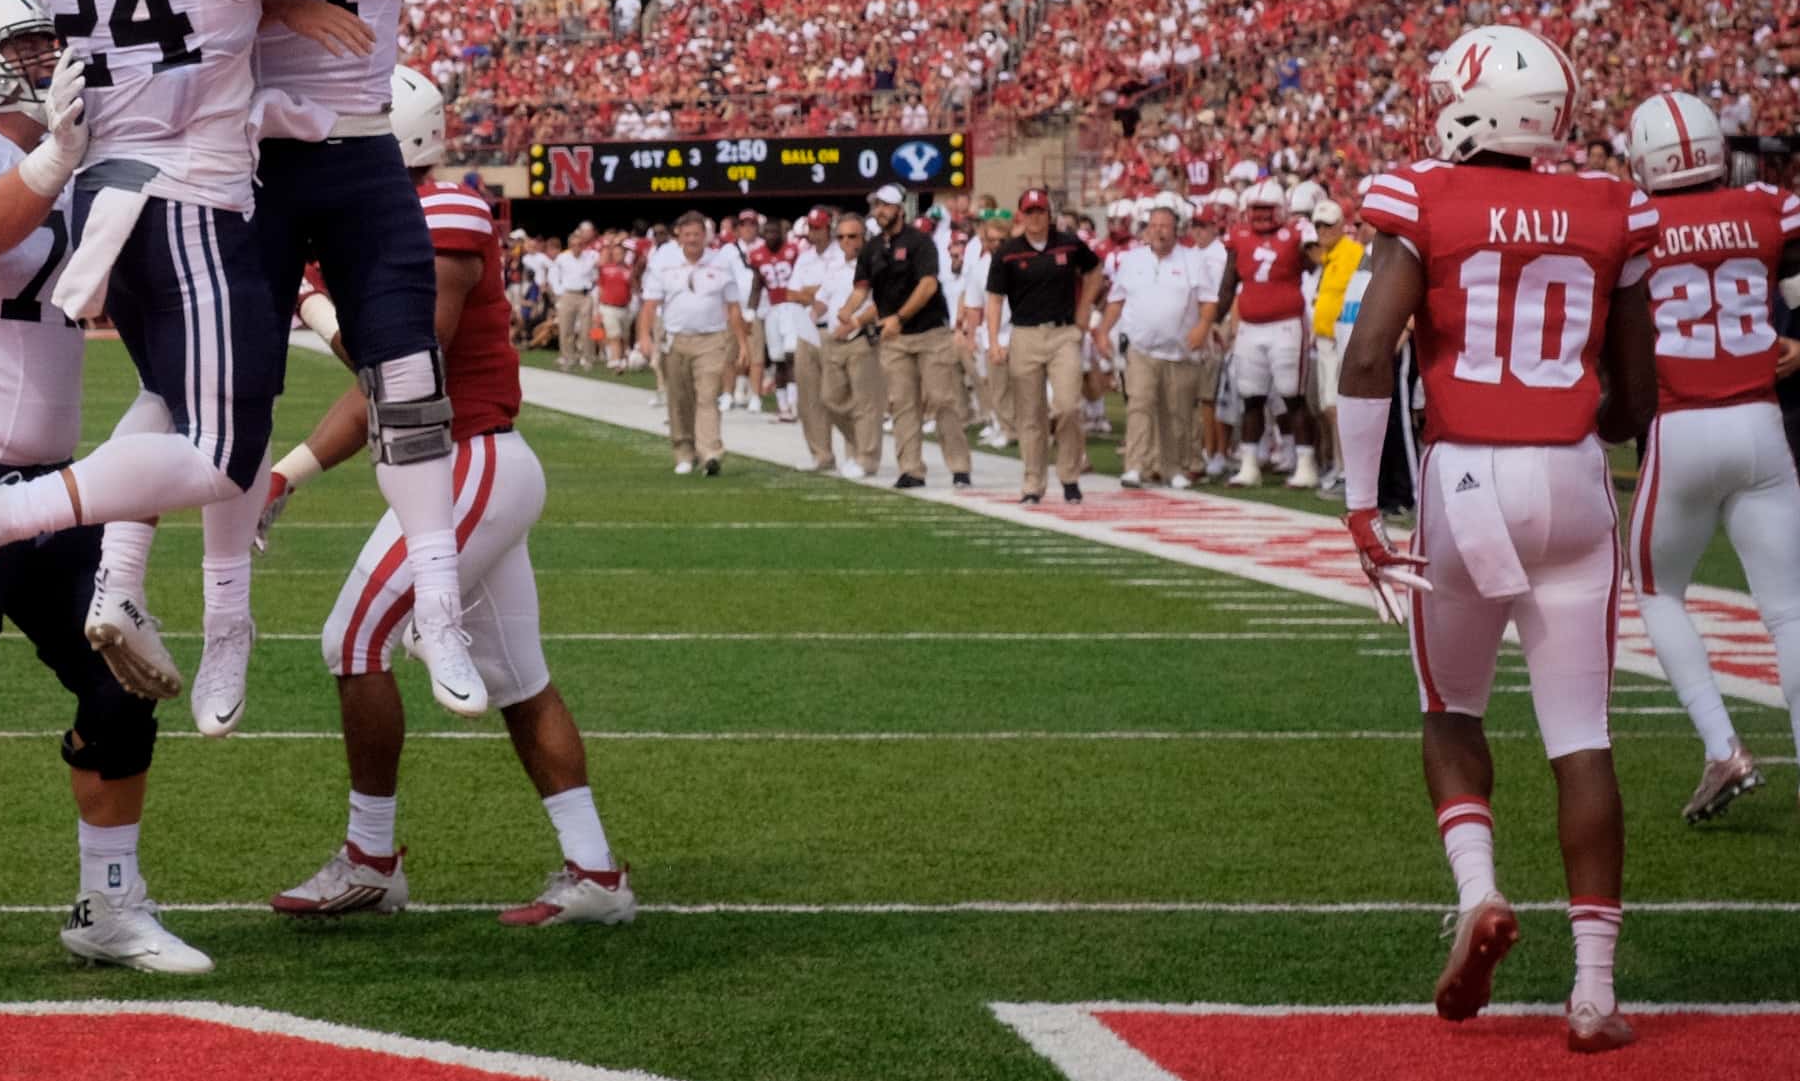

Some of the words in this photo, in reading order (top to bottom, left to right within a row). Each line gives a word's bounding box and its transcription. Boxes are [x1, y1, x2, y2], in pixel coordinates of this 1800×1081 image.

[629, 150, 665, 169] 1ST
[667, 148, 683, 167] &
[689, 147, 702, 167] 3
[715, 139, 768, 163] 2:50
[780, 148, 817, 166] BALL
[817, 148, 840, 164] ON
[857, 149, 879, 179] 0
[547, 146, 595, 196] N
[599, 155, 620, 183] 7
[810, 163, 826, 184] 3
[649, 176, 687, 192] POSS
[738, 178, 749, 195] 1
[1488, 206, 1571, 245] KALU
[1252, 246, 1279, 284] 7
[1453, 249, 1598, 389] 10
[1648, 257, 1778, 360] 28
